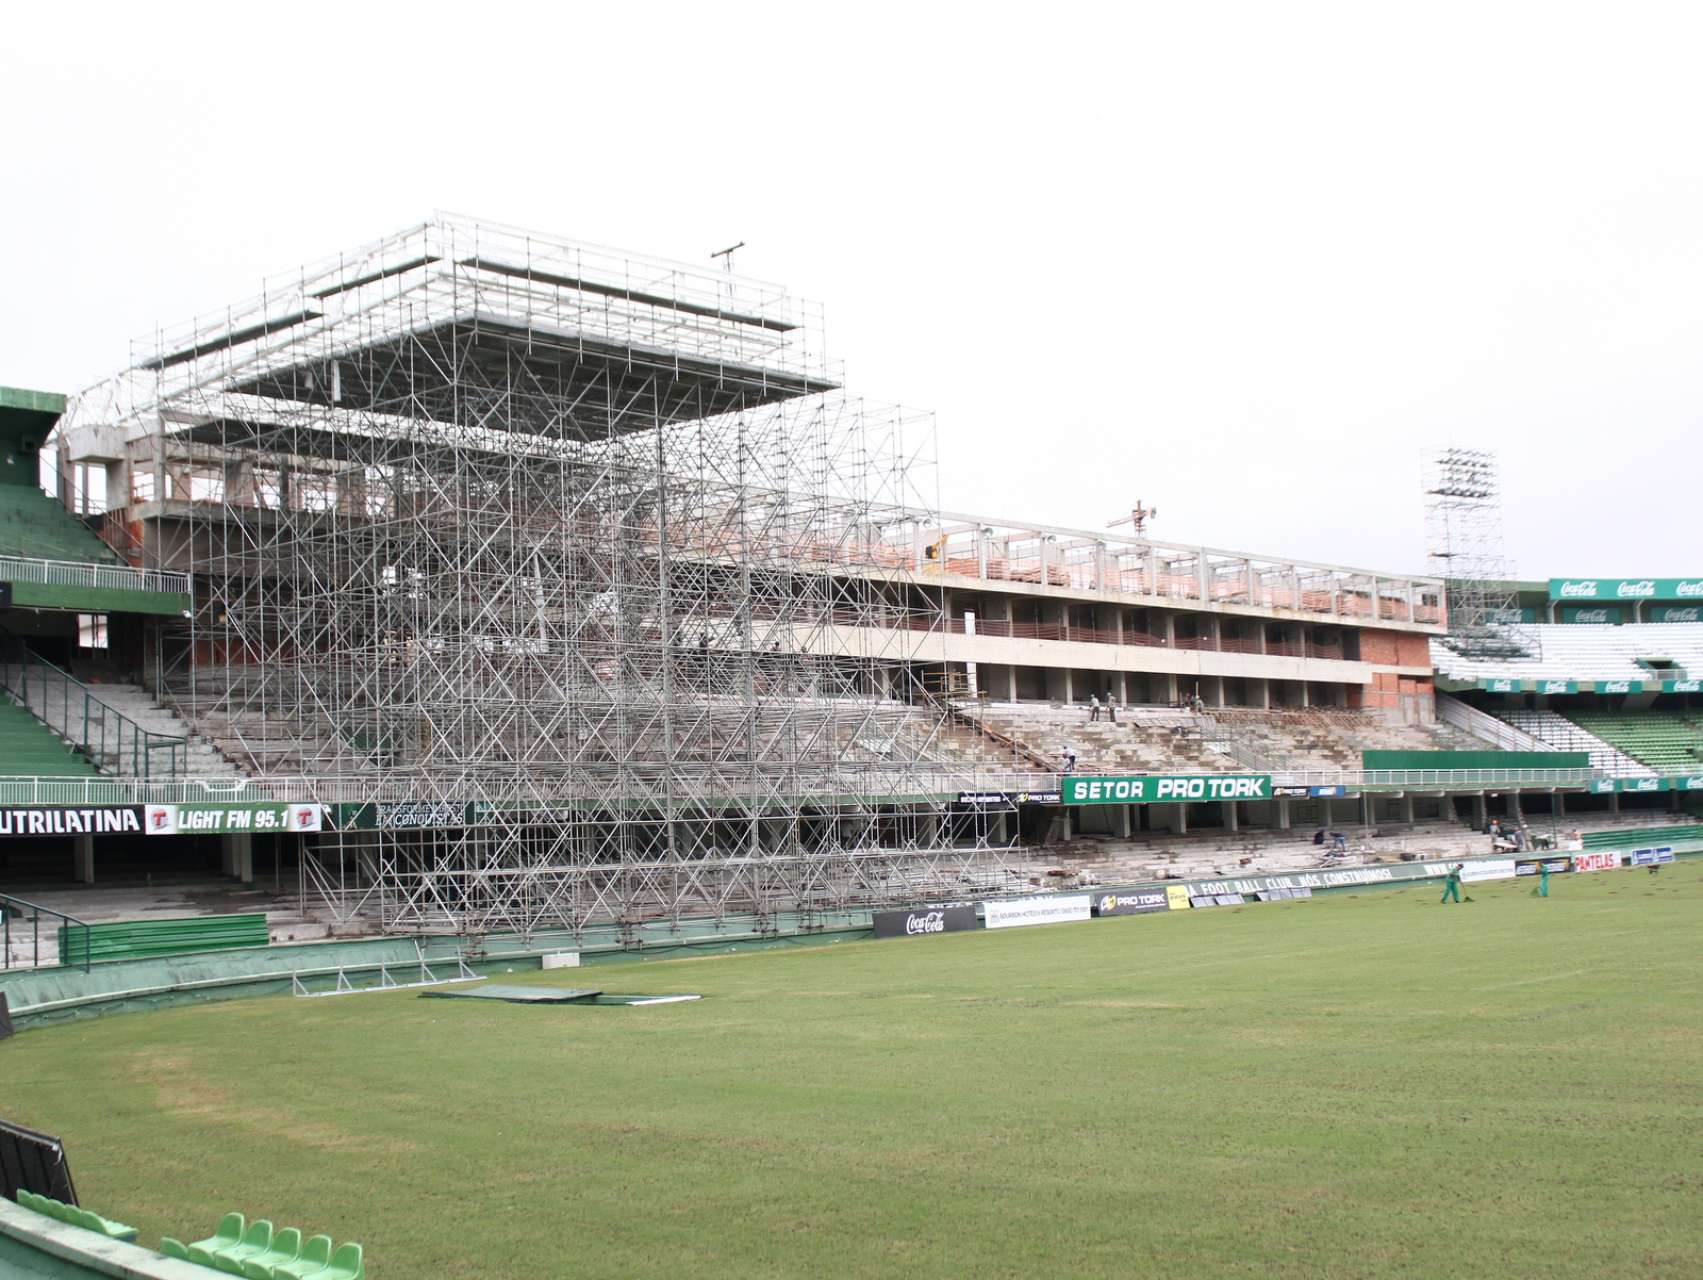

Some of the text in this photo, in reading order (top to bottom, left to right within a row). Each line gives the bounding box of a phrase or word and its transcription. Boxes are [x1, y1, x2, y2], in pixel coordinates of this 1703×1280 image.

[1074, 781, 1143, 800] SETOR
[1157, 779, 1205, 798] PRO
[1208, 778, 1264, 797] TORK
[178, 810, 289, 829] LIGHT FM 95.1
[1117, 896, 1138, 906] PRO
[1139, 893, 1165, 904] TORK
